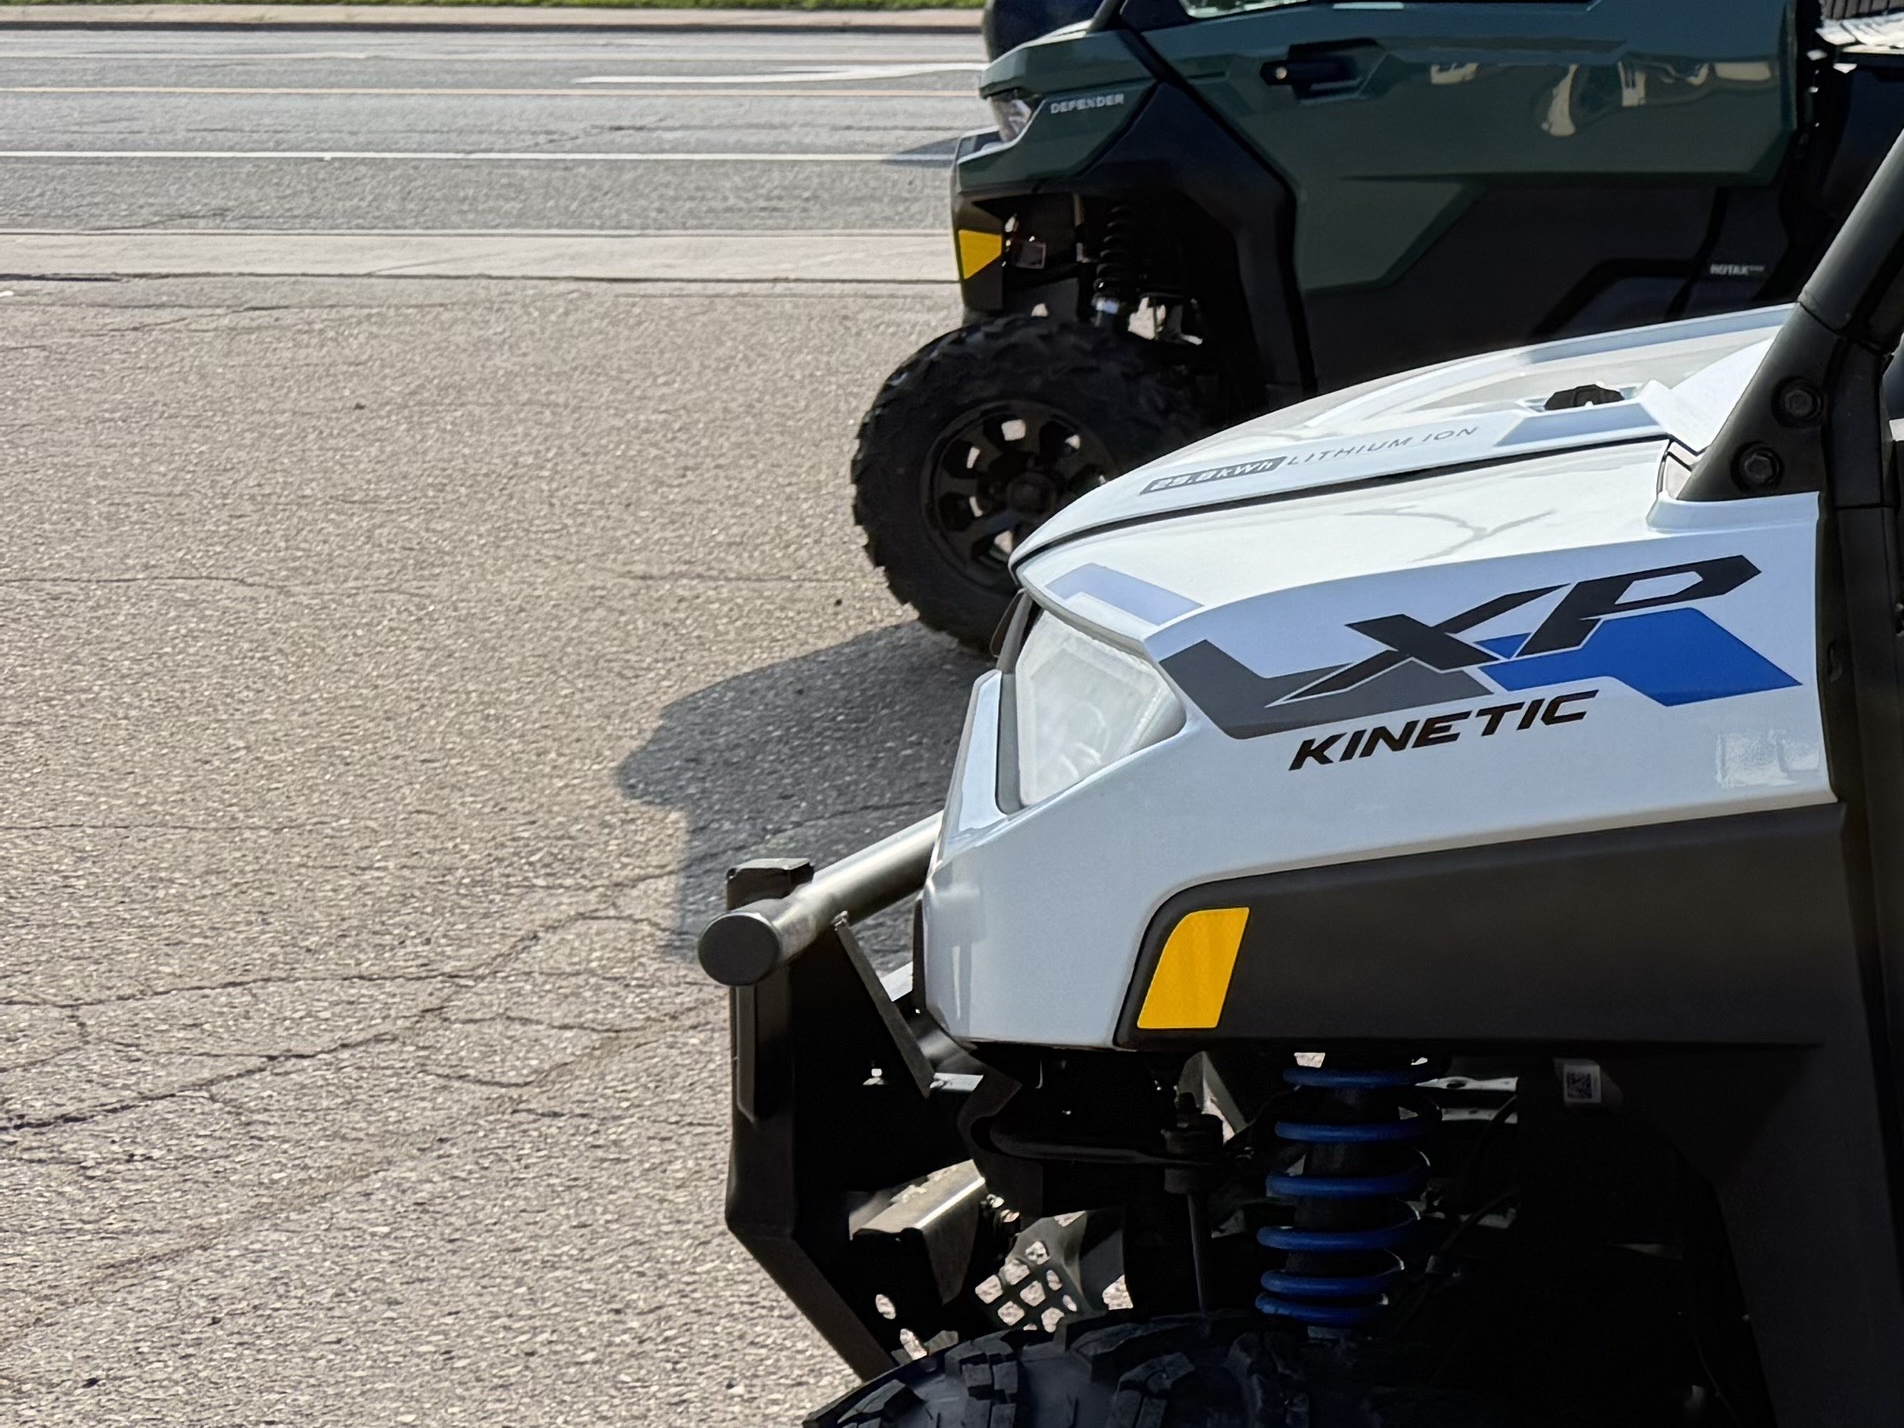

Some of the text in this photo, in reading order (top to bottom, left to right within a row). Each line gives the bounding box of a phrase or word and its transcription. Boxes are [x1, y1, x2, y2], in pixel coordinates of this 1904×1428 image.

[1050, 93, 1124, 114] DEFENDER
[1287, 437, 1413, 466] LITHIUM
[1422, 426, 1478, 442] ION
[1266, 554, 1762, 707] XP
[1288, 689, 1599, 771] KINETIC
